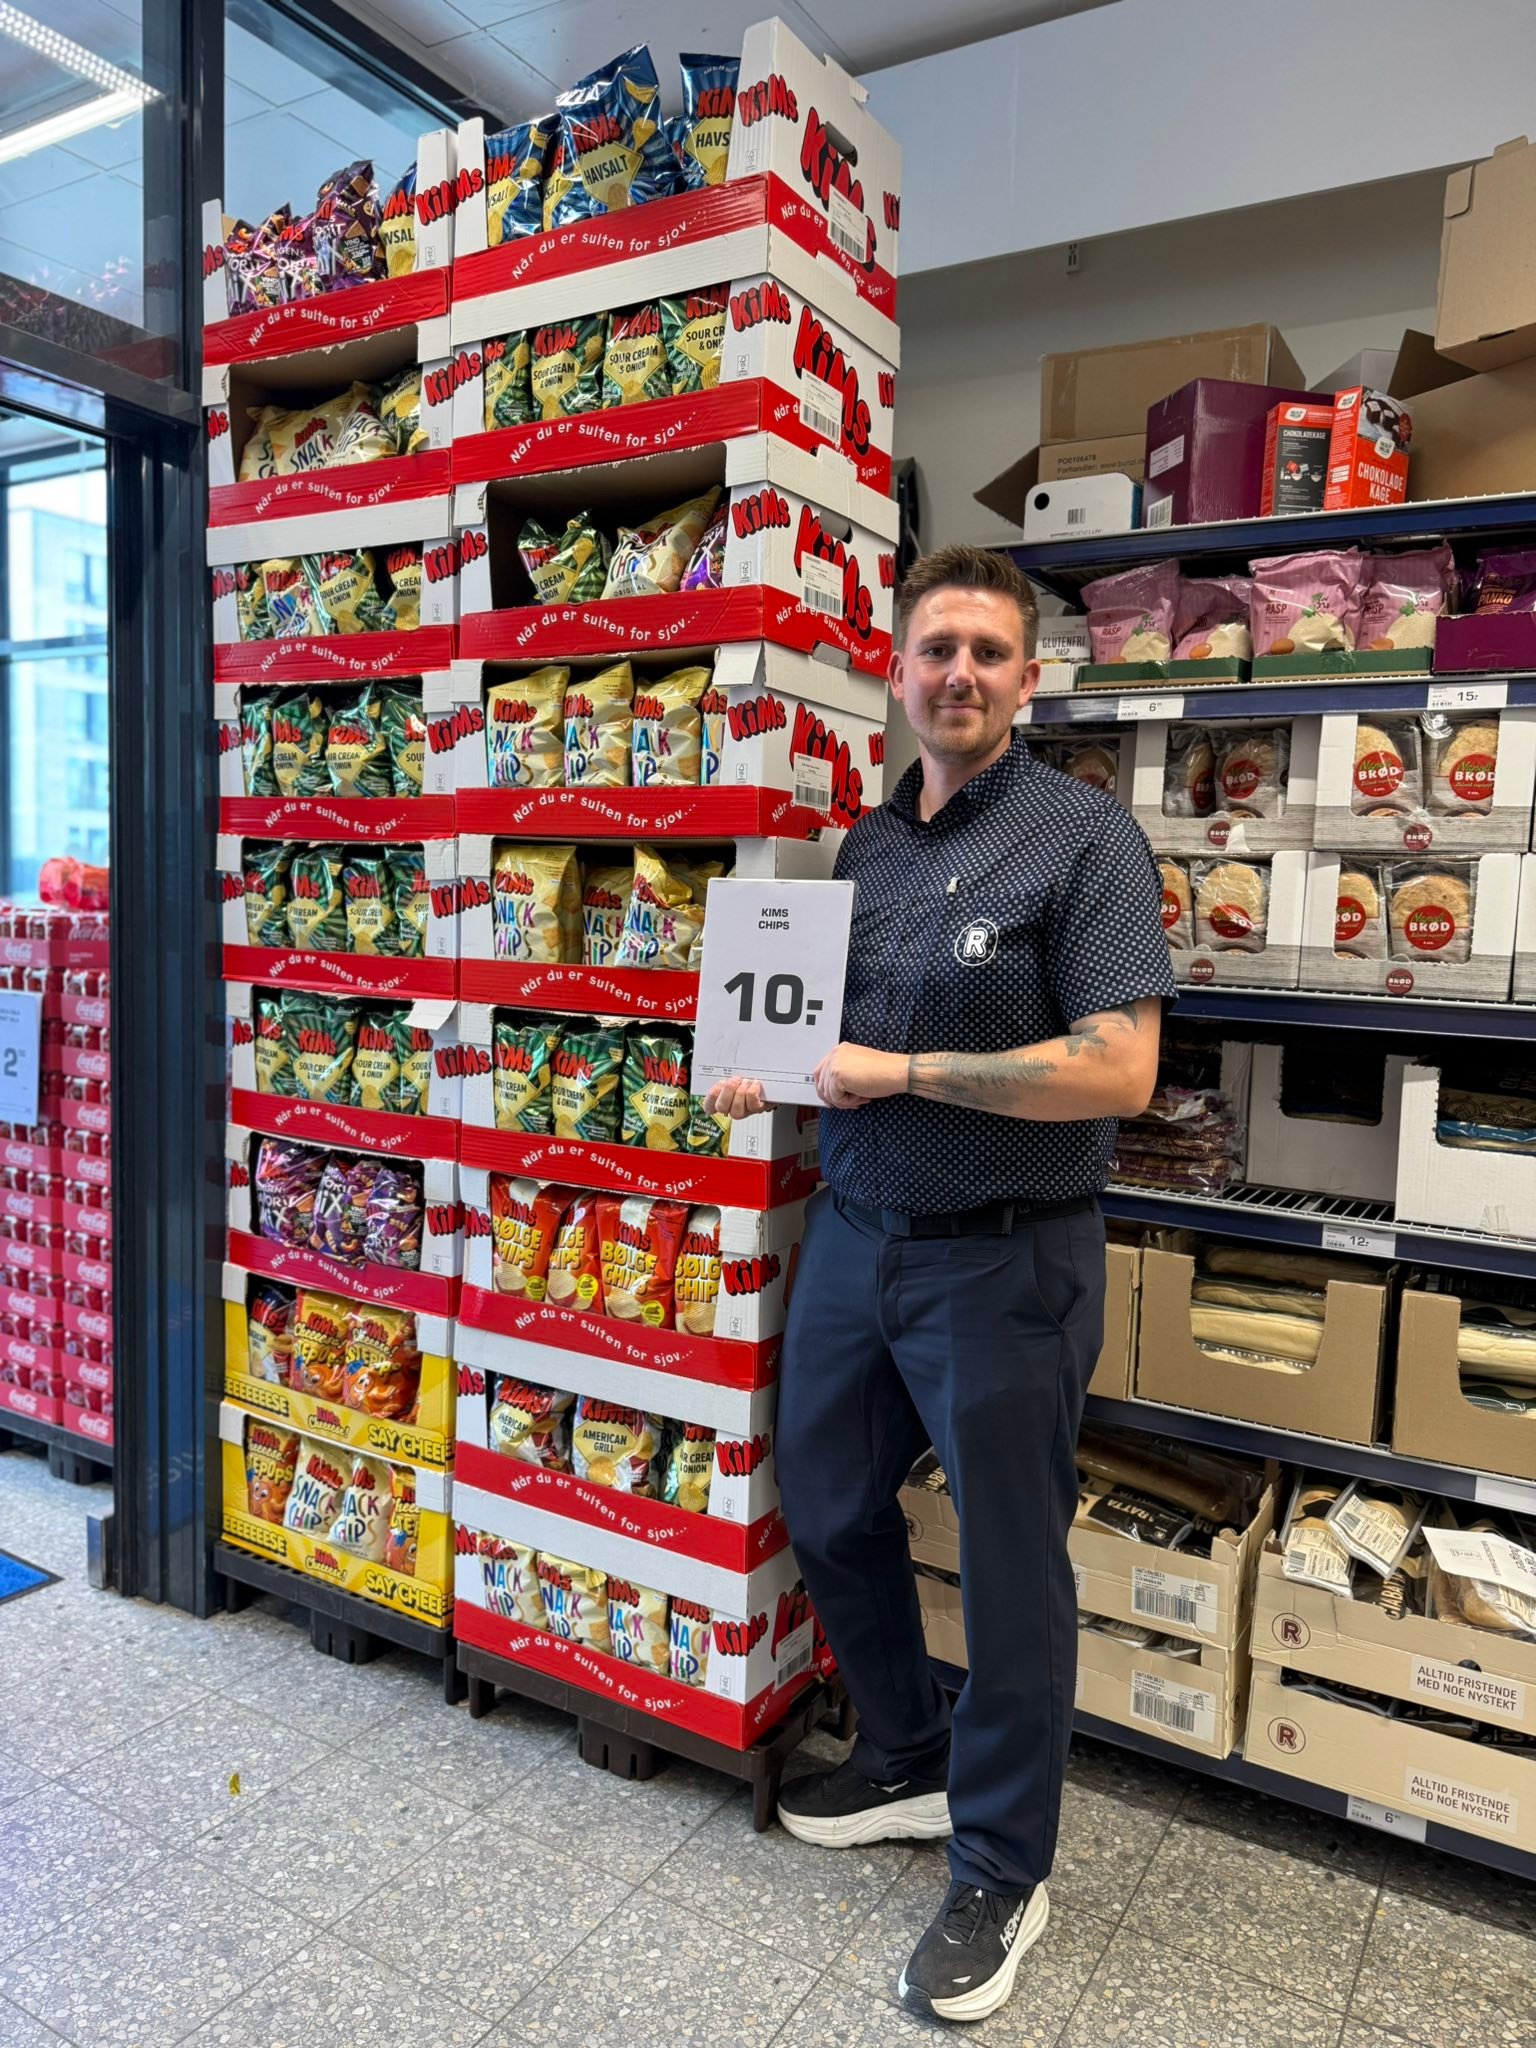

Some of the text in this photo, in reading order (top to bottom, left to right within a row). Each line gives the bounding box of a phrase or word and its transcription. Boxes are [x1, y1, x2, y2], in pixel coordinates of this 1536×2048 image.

[738, 73, 799, 127] KiMs
[583, 155, 628, 185] HAVSALT
[511, 252, 534, 280] Når
[538, 238, 556, 254] du
[560, 233, 576, 245] er
[581, 233, 624, 251] sulten
[629, 238, 651, 252] for
[730, 281, 791, 332] KiMs
[535, 326, 578, 357] KiMs
[609, 345, 658, 366] SOUR CREAM
[532, 363, 575, 380] SOUR CREAM
[545, 375, 563, 387] ONION
[626, 360, 646, 373] ONION
[510, 437, 532, 464] Når
[536, 426, 553, 441] du
[557, 422, 573, 434] er
[578, 423, 621, 445] sulten
[625, 432, 648, 447] for
[1283, 429, 1326, 439] CHOKOLADEKAGE
[1358, 462, 1402, 492] CHOKOLADE
[1369, 483, 1389, 503] KAGE
[731, 488, 790, 539] KiMs
[540, 573, 566, 590] CREAM
[1266, 604, 1287, 614] RASP
[1478, 592, 1513, 606] PANKO
[516, 622, 537, 647] Når
[541, 612, 558, 626] du
[562, 610, 578, 621] er
[582, 613, 625, 637] sulten
[629, 626, 652, 641] for
[1042, 636, 1085, 649] GLUTENFRI
[1102, 627, 1121, 636] RASP
[1056, 648, 1070, 656] RASP
[494, 698, 537, 723] KiMs
[727, 693, 787, 741] KiMs
[1226, 772, 1254, 784] BRØD
[1359, 766, 1399, 780] BRØD
[1455, 771, 1495, 781] BRØD
[264, 808, 282, 828] Når
[283, 801, 297, 814] du
[299, 801, 312, 811] er
[315, 805, 350, 829] sulten
[353, 820, 371, 834] for
[512, 801, 535, 824] Når
[538, 793, 555, 806] du
[559, 793, 575, 803] er
[580, 796, 622, 822] sulten
[626, 813, 649, 828] for
[497, 869, 534, 896] KiMs
[759, 921, 789, 930] CHIPS
[761, 908, 788, 918] KIMS
[1409, 922, 1450, 932] BRØD
[965, 927, 988, 958] R
[520, 976, 542, 997] Når
[546, 969, 563, 982] du
[567, 970, 584, 981] er
[588, 975, 632, 1002] sulten
[636, 995, 658, 1010] for
[299, 1028, 336, 1055] KiMs
[359, 1026, 394, 1051] KiMs
[356, 1059, 390, 1070] SOUR CREAM
[366, 1070, 382, 1078] ONION
[554, 1050, 593, 1079] KiMs
[643, 1056, 688, 1086] KiMs
[563, 1099, 578, 1109] ONION
[567, 1090, 585, 1101] CREAM
[642, 1093, 687, 1108] SOUR CREAM
[654, 1106, 674, 1117] ONION
[521, 1149, 544, 1168] Når
[547, 1143, 565, 1155] du
[569, 1146, 585, 1157] er
[589, 1152, 633, 1181] sulten
[637, 1174, 659, 1191] for
[501, 1201, 537, 1227] KiMs
[492, 1215, 543, 1251] BØLGE
[614, 1220, 650, 1250] KiMs
[602, 1241, 658, 1275] BØLGE
[603, 1266, 649, 1295] CHIPS
[722, 1254, 780, 1296] KiMs
[514, 1311, 536, 1330] Når
[540, 1307, 556, 1319] du
[560, 1311, 575, 1322] er
[580, 1319, 622, 1350] sulten
[626, 1344, 648, 1361] for
[500, 1377, 544, 1414] KiMs
[581, 1397, 634, 1425] KiMs
[368, 1424, 399, 1453] SAY
[583, 1429, 627, 1445] AMERICAN
[594, 1442, 615, 1453] GRILL
[716, 1432, 770, 1476] KiMs
[306, 1454, 343, 1490] KiMs
[292, 1474, 336, 1514] SNACK
[510, 1475, 532, 1492] Når
[535, 1472, 552, 1484] du
[555, 1477, 571, 1489] er
[575, 1484, 616, 1522] sulten
[620, 1516, 641, 1534] for
[288, 1503, 331, 1532] CHIPS
[365, 1569, 397, 1600] SAY
[712, 1612, 768, 1656] KiMs
[509, 1636, 530, 1652] Når
[534, 1634, 550, 1647] du
[554, 1641, 569, 1653] er
[573, 1652, 614, 1688] sulten
[618, 1684, 639, 1702] for
[1418, 1666, 1517, 1699] ALLTID FRISTENDE
[1417, 1677, 1516, 1711] MED NOE NYSTEKT
[1411, 1787, 1510, 1824] MED NOE NYSTEKT
[1412, 1776, 1510, 1813] ALLTID FRISTENDE
